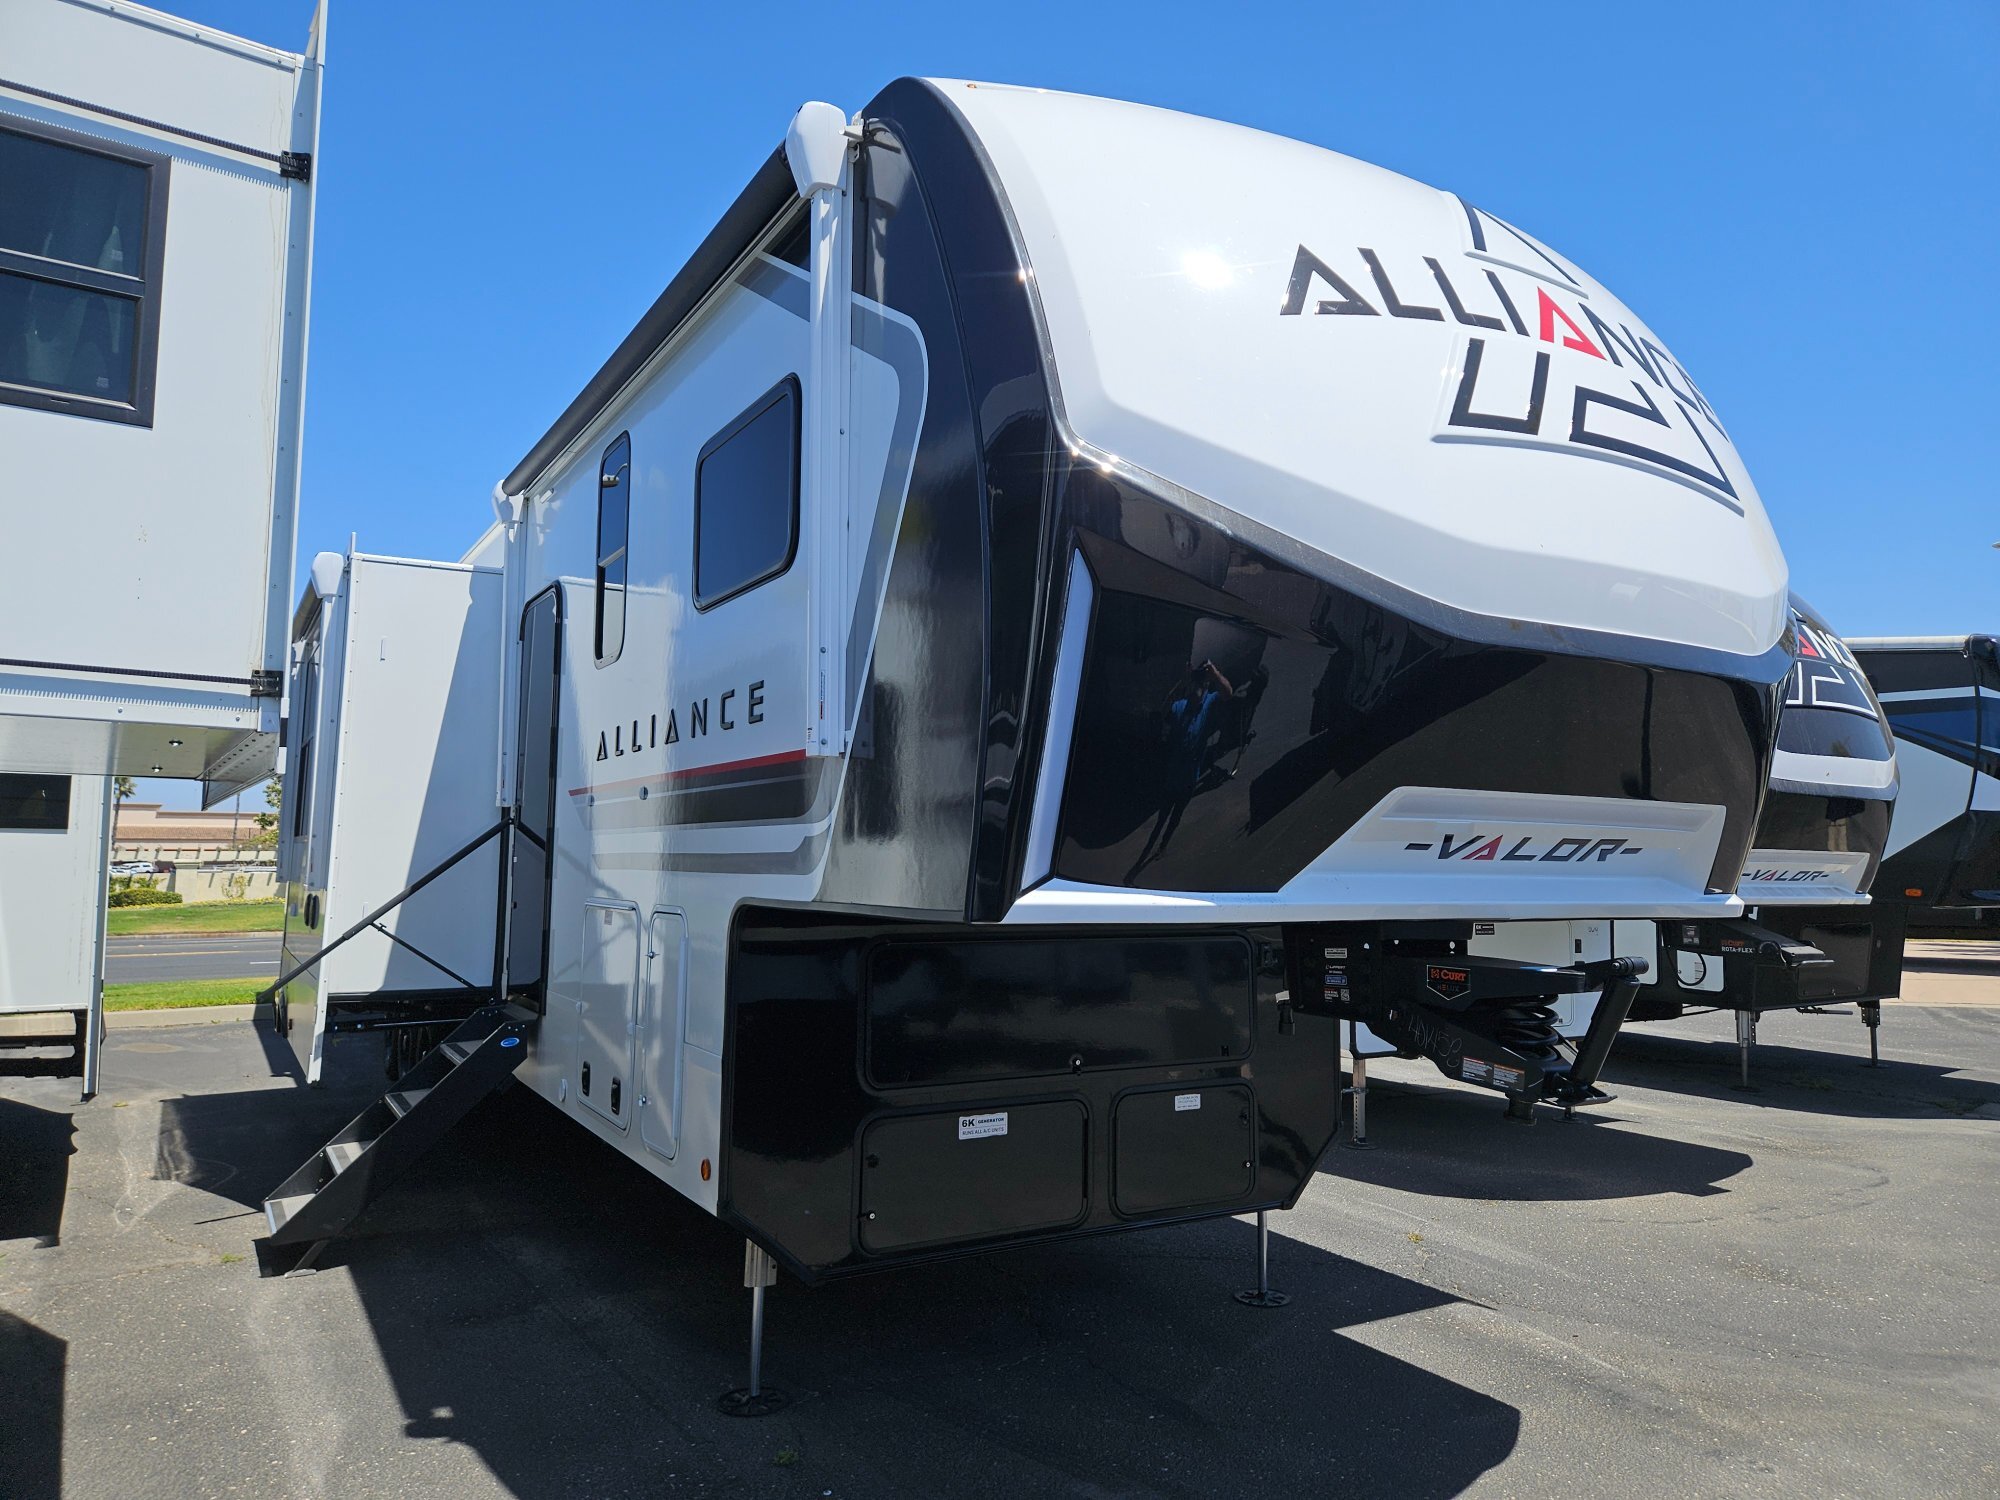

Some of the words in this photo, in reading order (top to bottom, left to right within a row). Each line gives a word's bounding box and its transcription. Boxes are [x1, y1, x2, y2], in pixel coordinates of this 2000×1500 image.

[1280, 243, 1729, 443] ALLIANCE
[596, 679, 765, 761] ALLIANCE
[961, 1118, 975, 1127] 6K
